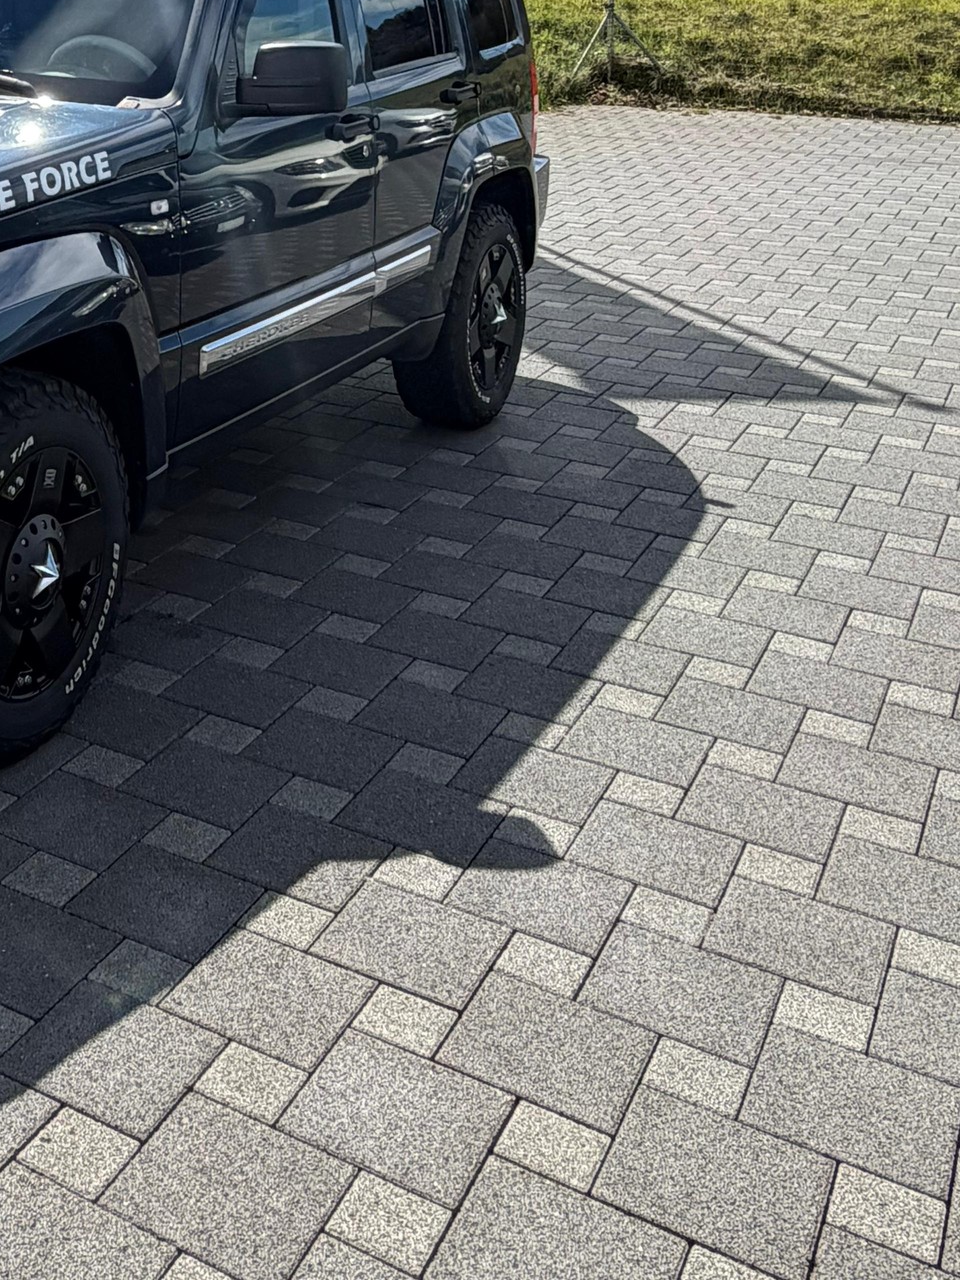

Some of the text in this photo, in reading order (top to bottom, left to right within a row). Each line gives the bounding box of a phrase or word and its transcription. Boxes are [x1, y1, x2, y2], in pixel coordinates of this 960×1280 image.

[21, 150, 112, 203] FORCE
[220, 312, 311, 359] CHEROKEE
[9, 435, 36, 464] T/A
[65, 542, 121, 695] BFGoodrich
